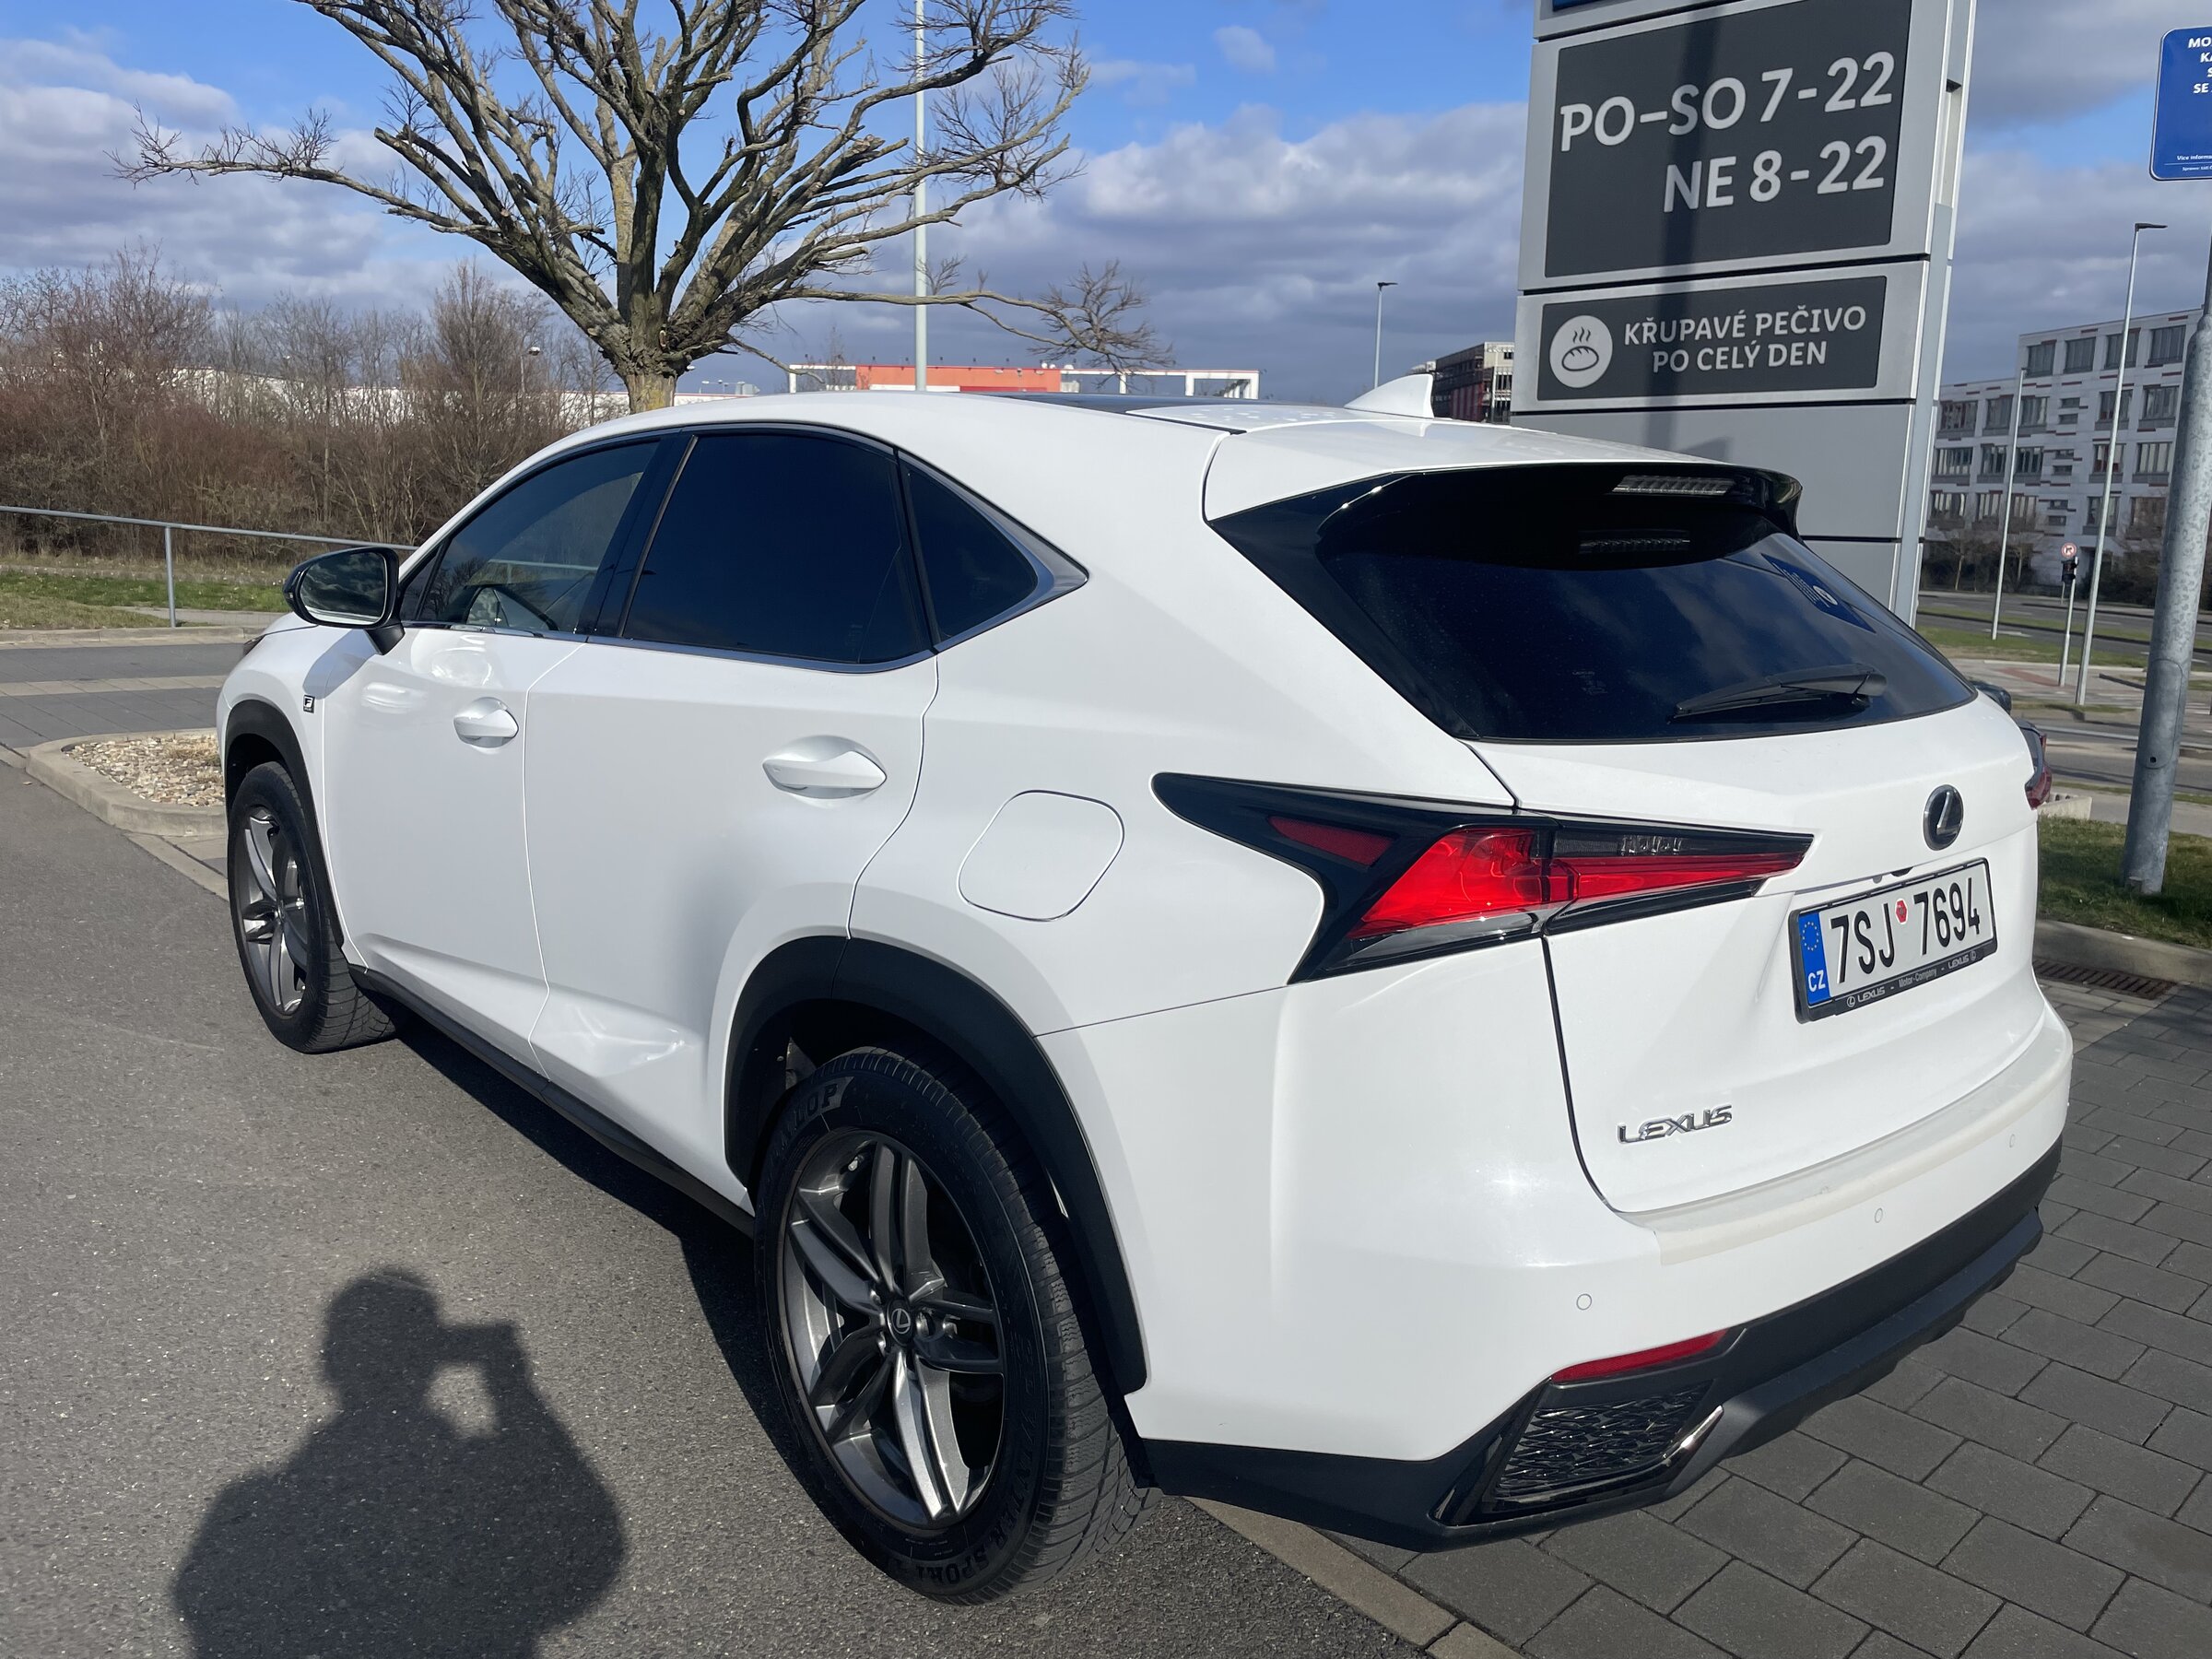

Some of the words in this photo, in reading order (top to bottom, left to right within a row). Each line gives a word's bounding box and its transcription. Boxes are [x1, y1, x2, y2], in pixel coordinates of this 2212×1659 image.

[2193, 83, 2209, 94] SE
[1664, 157, 1736, 213] NE
[1624, 310, 1747, 346] KŘUPAVÉ
[1755, 305, 1866, 336] PEČIVO
[1653, 348, 1689, 373] PO
[1697, 340, 1760, 371] CELÝ
[1768, 340, 1827, 368] DEN
[1830, 902, 1895, 984] 7SJ
[1913, 877, 1981, 956] 7694
[1807, 969, 1827, 993] CZ
[1856, 986, 1886, 1003] LEXUS
[1947, 954, 1971, 970] LEXUS
[1617, 1104, 1733, 1144] LEXUS
